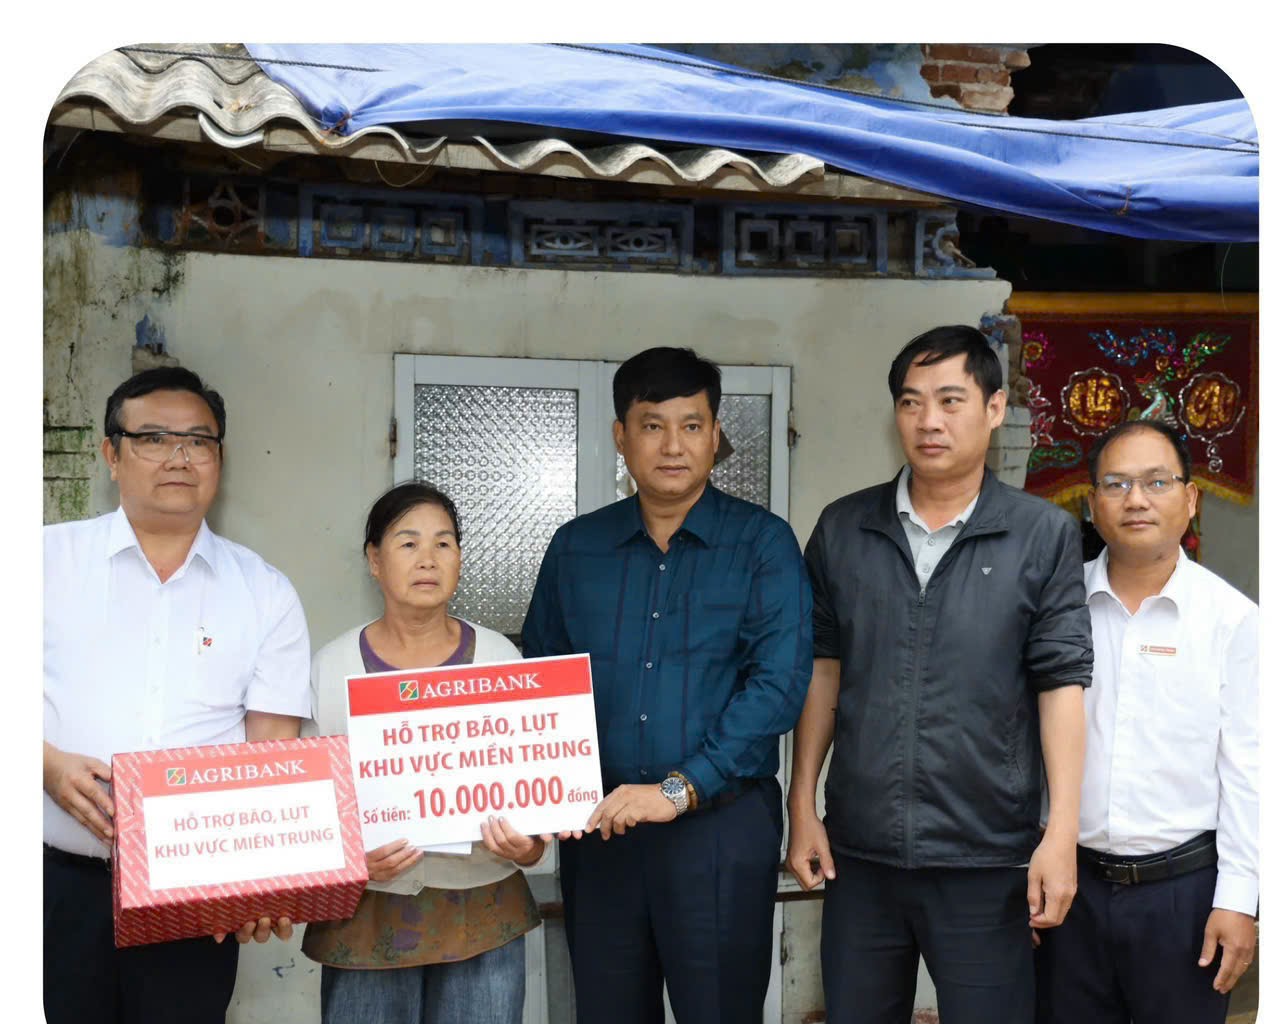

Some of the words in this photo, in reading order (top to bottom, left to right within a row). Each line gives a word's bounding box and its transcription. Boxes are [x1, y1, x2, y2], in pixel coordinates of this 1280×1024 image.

[423, 673, 541, 699] AGRIBANK
[383, 720, 413, 746] HỖ
[418, 720, 461, 744] TRỢ
[466, 715, 515, 738] BÃO,
[522, 713, 559, 736] LỤT
[190, 760, 306, 785] AGRIBANK
[359, 758, 404, 779] KHU
[410, 751, 454, 776] VỰC
[460, 742, 514, 768] MIỀN
[518, 739, 592, 762] TRUNG
[364, 808, 380, 825] Số
[381, 806, 411, 822] tiền:
[414, 775, 564, 819] 10.000.000
[568, 788, 598, 805] đồng
[174, 812, 199, 832] HỖ
[202, 813, 235, 830] TRỢ
[239, 807, 278, 826] BÃO,
[281, 806, 309, 824] LỤT
[155, 843, 190, 858] KHU
[195, 837, 228, 858] VỰC
[233, 831, 275, 851] MIỀN
[278, 827, 334, 846] TRUNG
